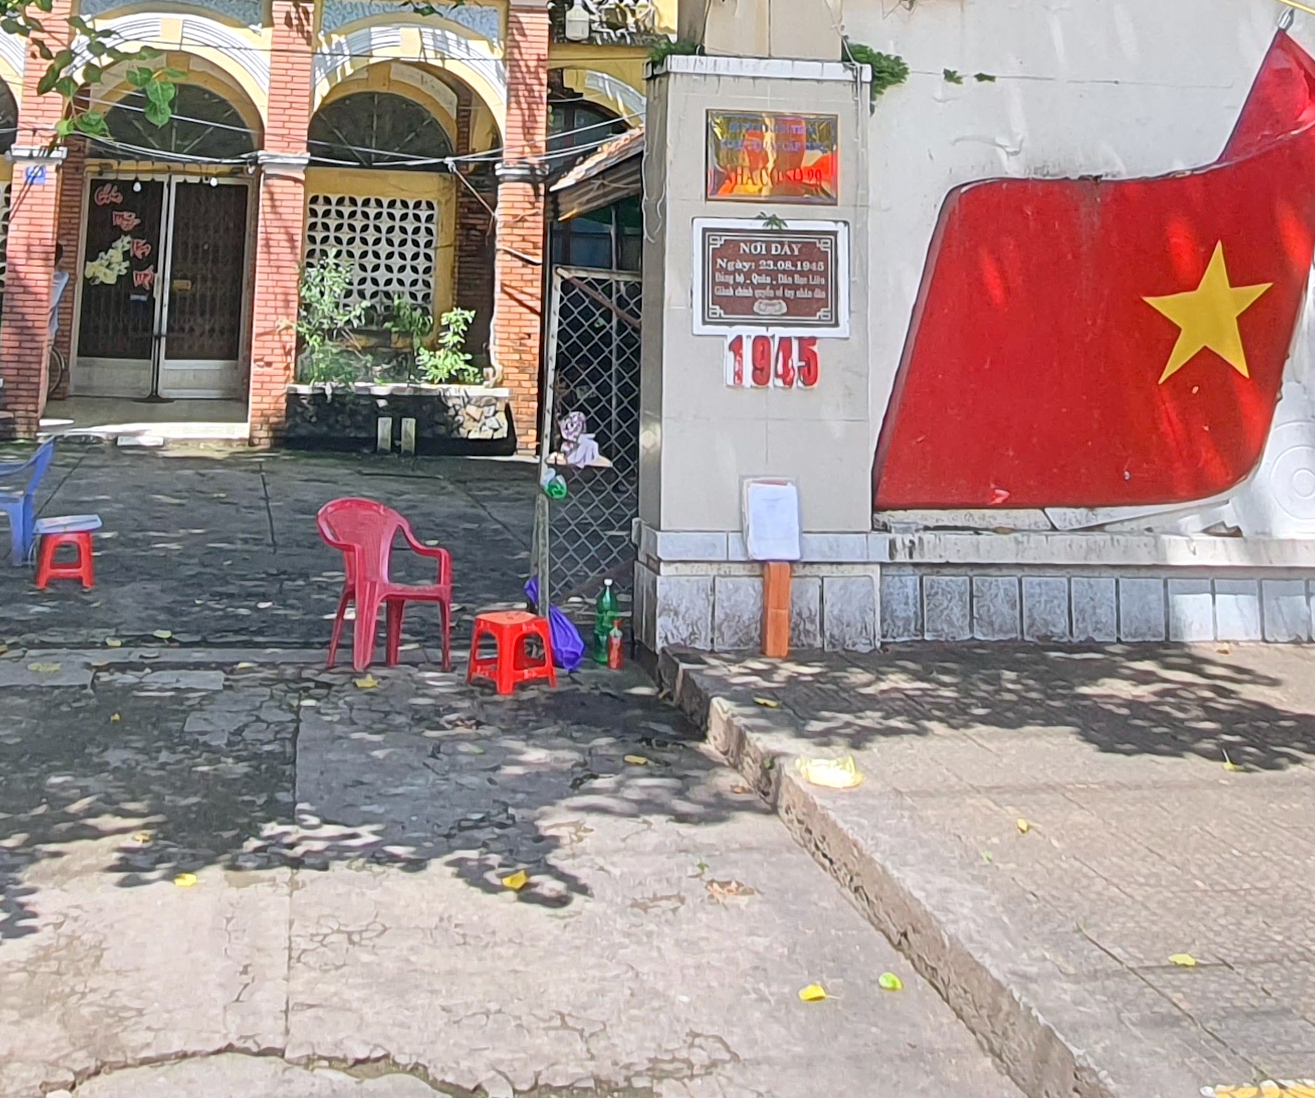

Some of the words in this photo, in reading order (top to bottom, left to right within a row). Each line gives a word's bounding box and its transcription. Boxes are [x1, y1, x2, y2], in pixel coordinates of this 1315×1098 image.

[716, 258, 755, 271] Ngày:
[759, 260, 825, 271] 23.08.1945
[727, 334, 818, 388] 1945
